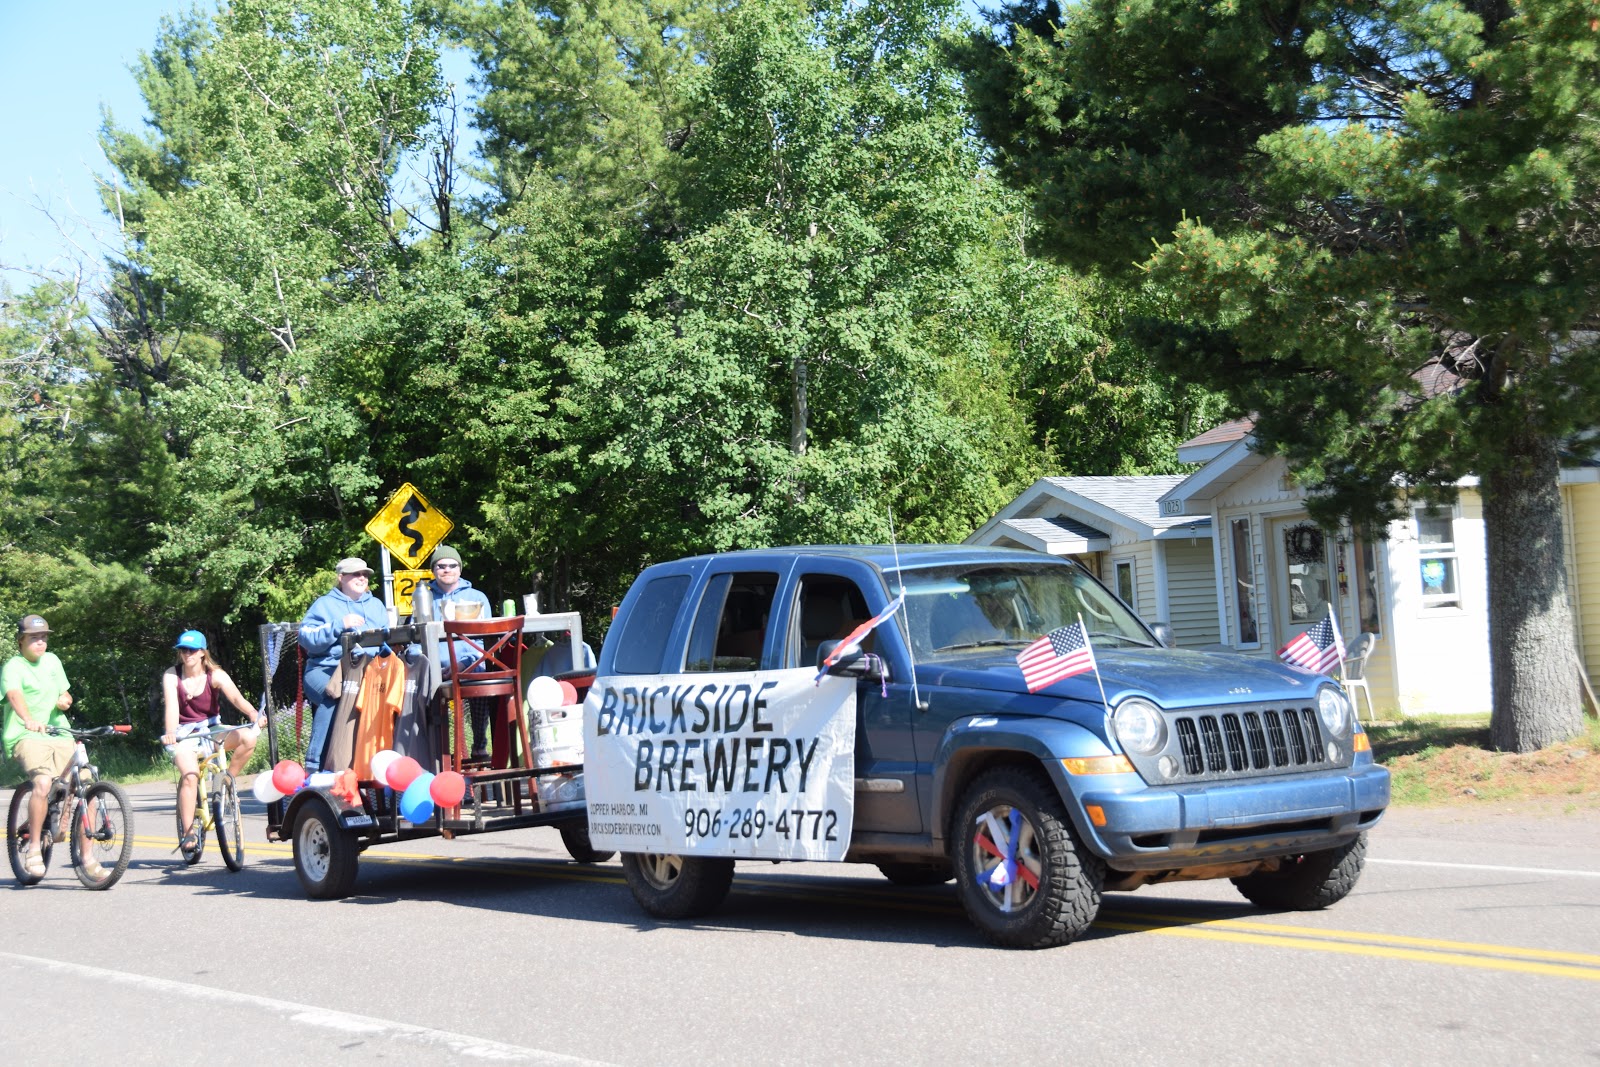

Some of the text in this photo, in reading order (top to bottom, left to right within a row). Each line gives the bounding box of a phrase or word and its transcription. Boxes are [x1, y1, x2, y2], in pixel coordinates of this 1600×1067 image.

[1164, 501, 1180, 513] 1025
[400, 577, 431, 596] 2
[597, 681, 778, 735] BRICKSIDE
[634, 737, 819, 794] BREWERY
[639, 803, 648, 816] MI
[684, 808, 838, 841] 906-289-4772
